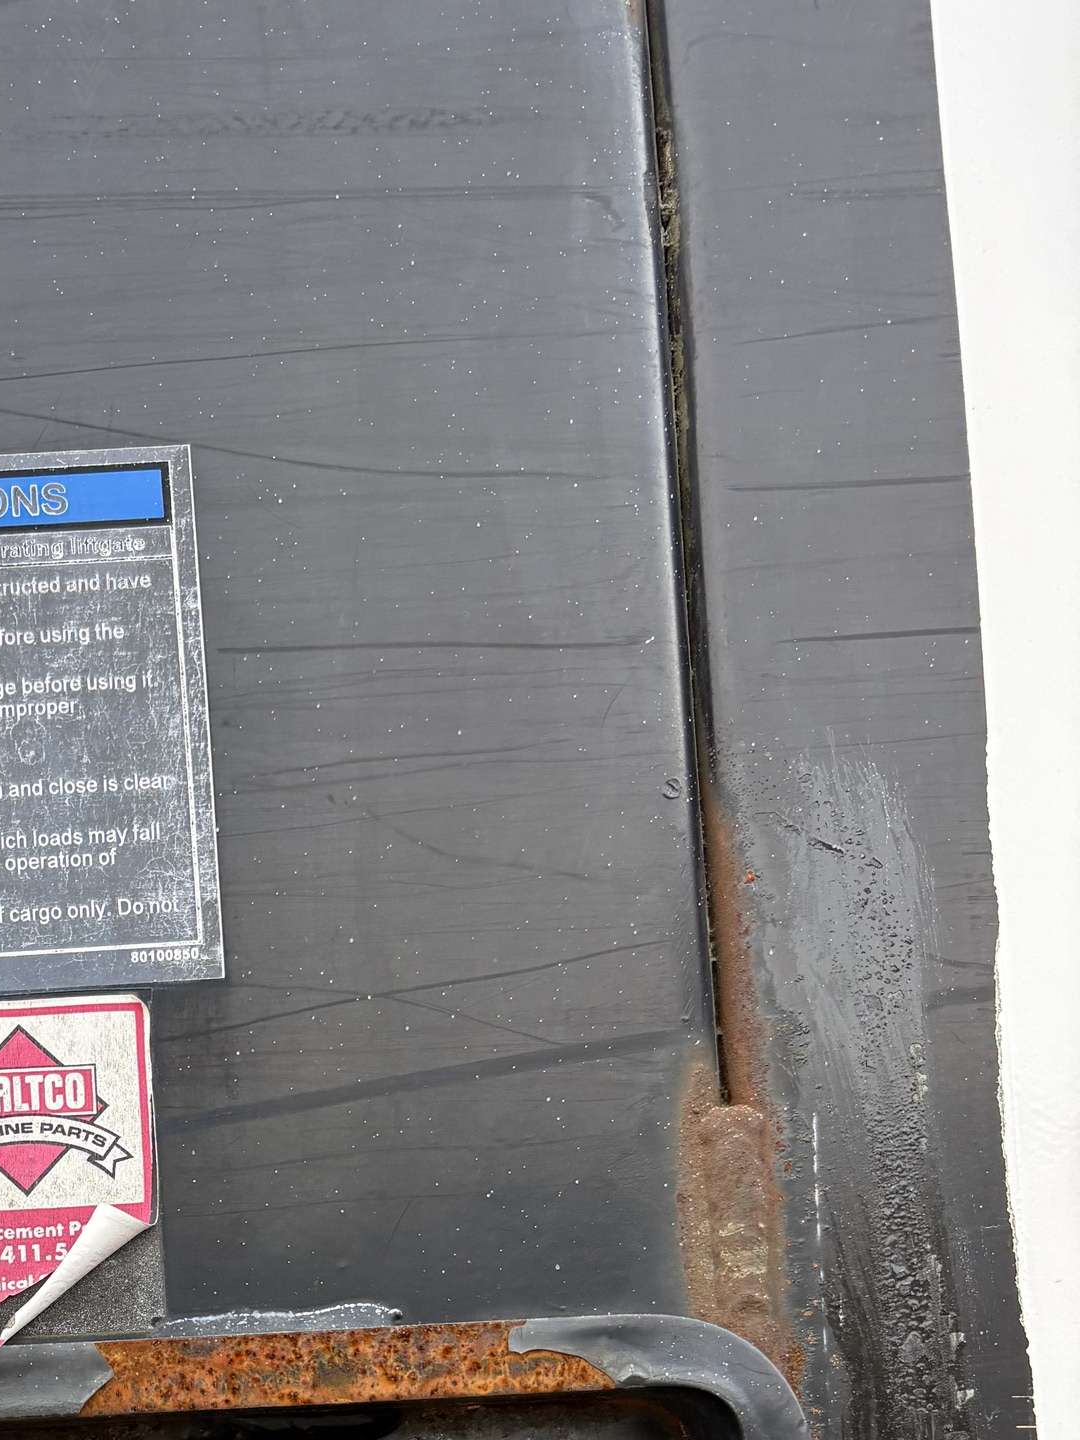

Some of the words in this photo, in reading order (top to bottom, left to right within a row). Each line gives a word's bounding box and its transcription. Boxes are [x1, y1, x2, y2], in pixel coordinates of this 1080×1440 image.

[70, 533, 146, 557] liftgate
[39, 625, 90, 647] using
[95, 622, 124, 640] the
[22, 675, 81, 694] before
[86, 673, 137, 695] using
[8, 779, 43, 798] and
[48, 776, 98, 795] close
[103, 775, 117, 792] is
[123, 772, 168, 791] clear
[32, 828, 82, 847] loads
[88, 828, 128, 848] may
[132, 823, 160, 841] fall
[4, 849, 92, 874] operation
[98, 848, 117, 865] of
[9, 905, 62, 926] cargo
[67, 899, 110, 922] only.
[116, 897, 143, 916] Do
[148, 896, 179, 913] not
[40, 1123, 107, 1147] PARTS
